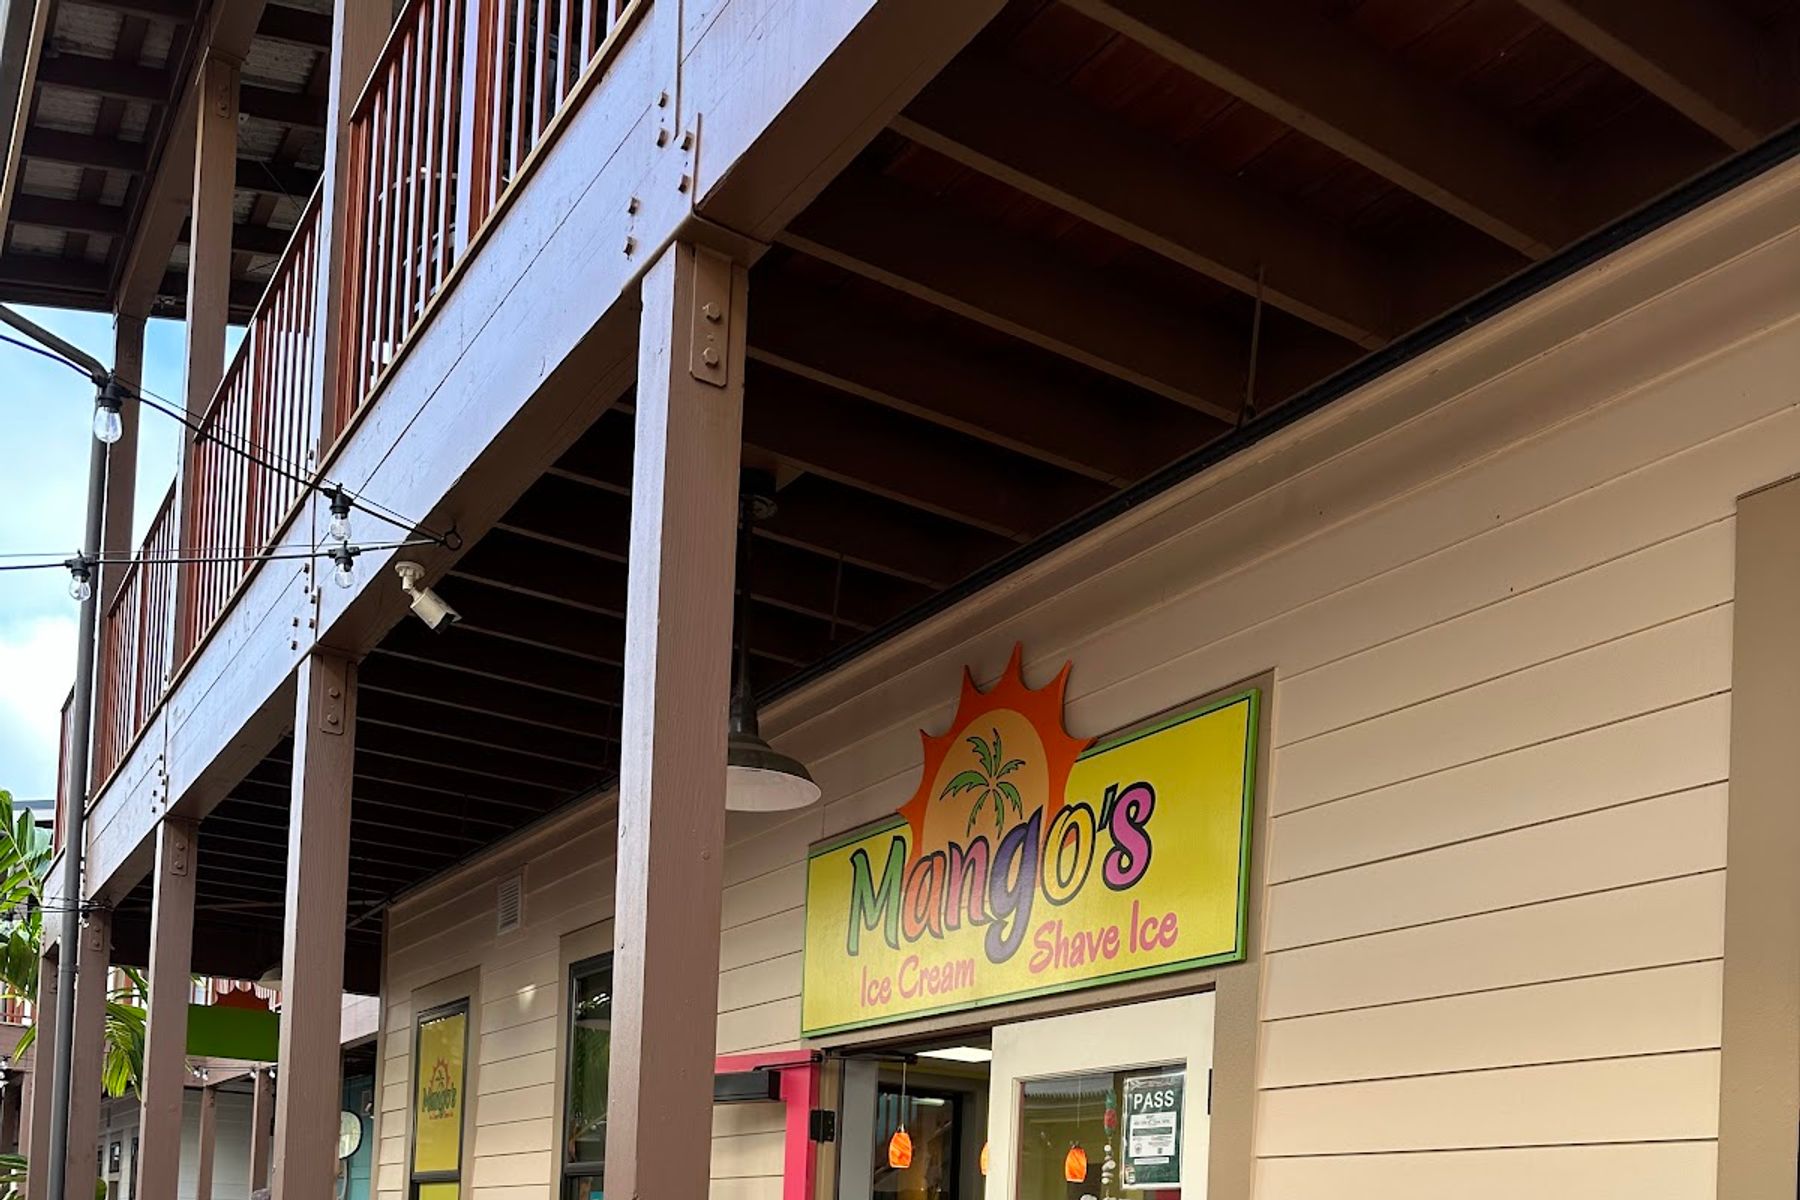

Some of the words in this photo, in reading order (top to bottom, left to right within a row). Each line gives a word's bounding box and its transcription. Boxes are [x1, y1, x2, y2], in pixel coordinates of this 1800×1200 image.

[846, 781, 1156, 963] Mango's
[1029, 919, 1120, 975] Shave
[1129, 899, 1179, 954] Ice
[861, 965, 893, 1008] Ice
[898, 954, 975, 1000] Cream
[1133, 1089, 1175, 1112] PASS
